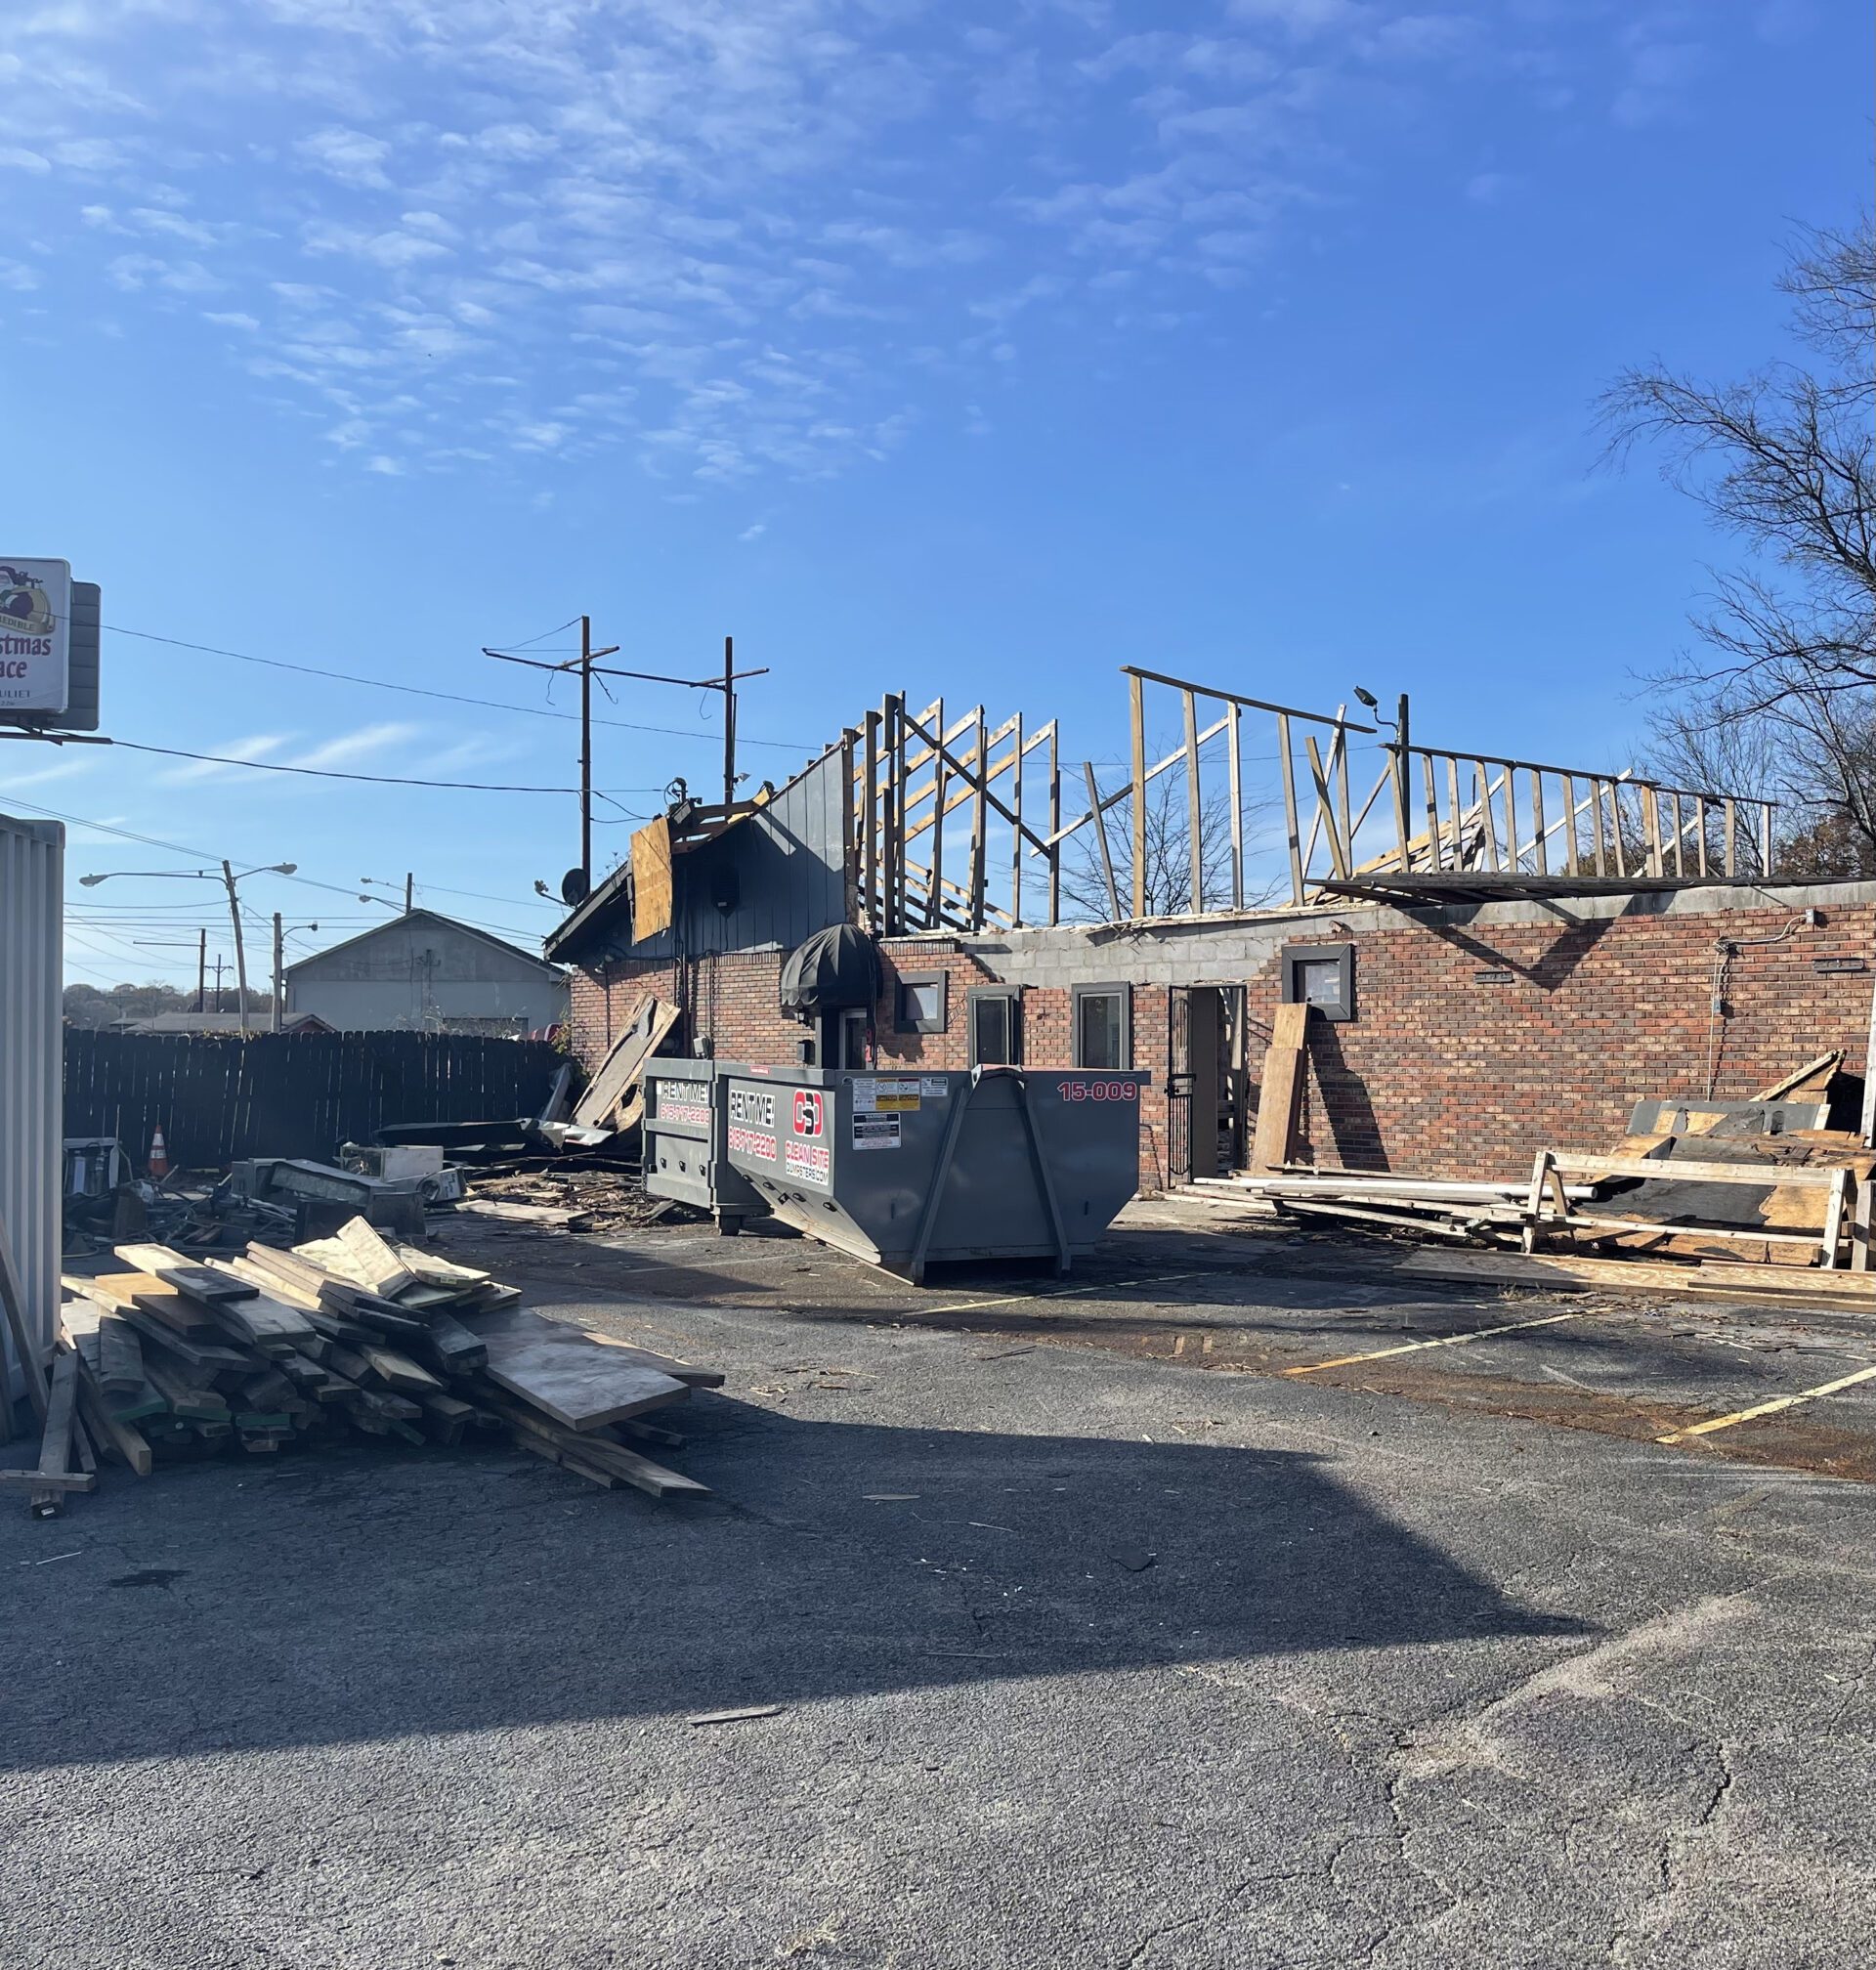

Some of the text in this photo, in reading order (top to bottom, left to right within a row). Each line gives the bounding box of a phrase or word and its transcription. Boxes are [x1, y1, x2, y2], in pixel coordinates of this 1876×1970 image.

[662, 1080, 689, 1102] RENT
[1057, 1082, 1136, 1101] 15-009
[731, 1090, 755, 1123] RENT
[786, 1140, 830, 1170] CLEAN SITE
